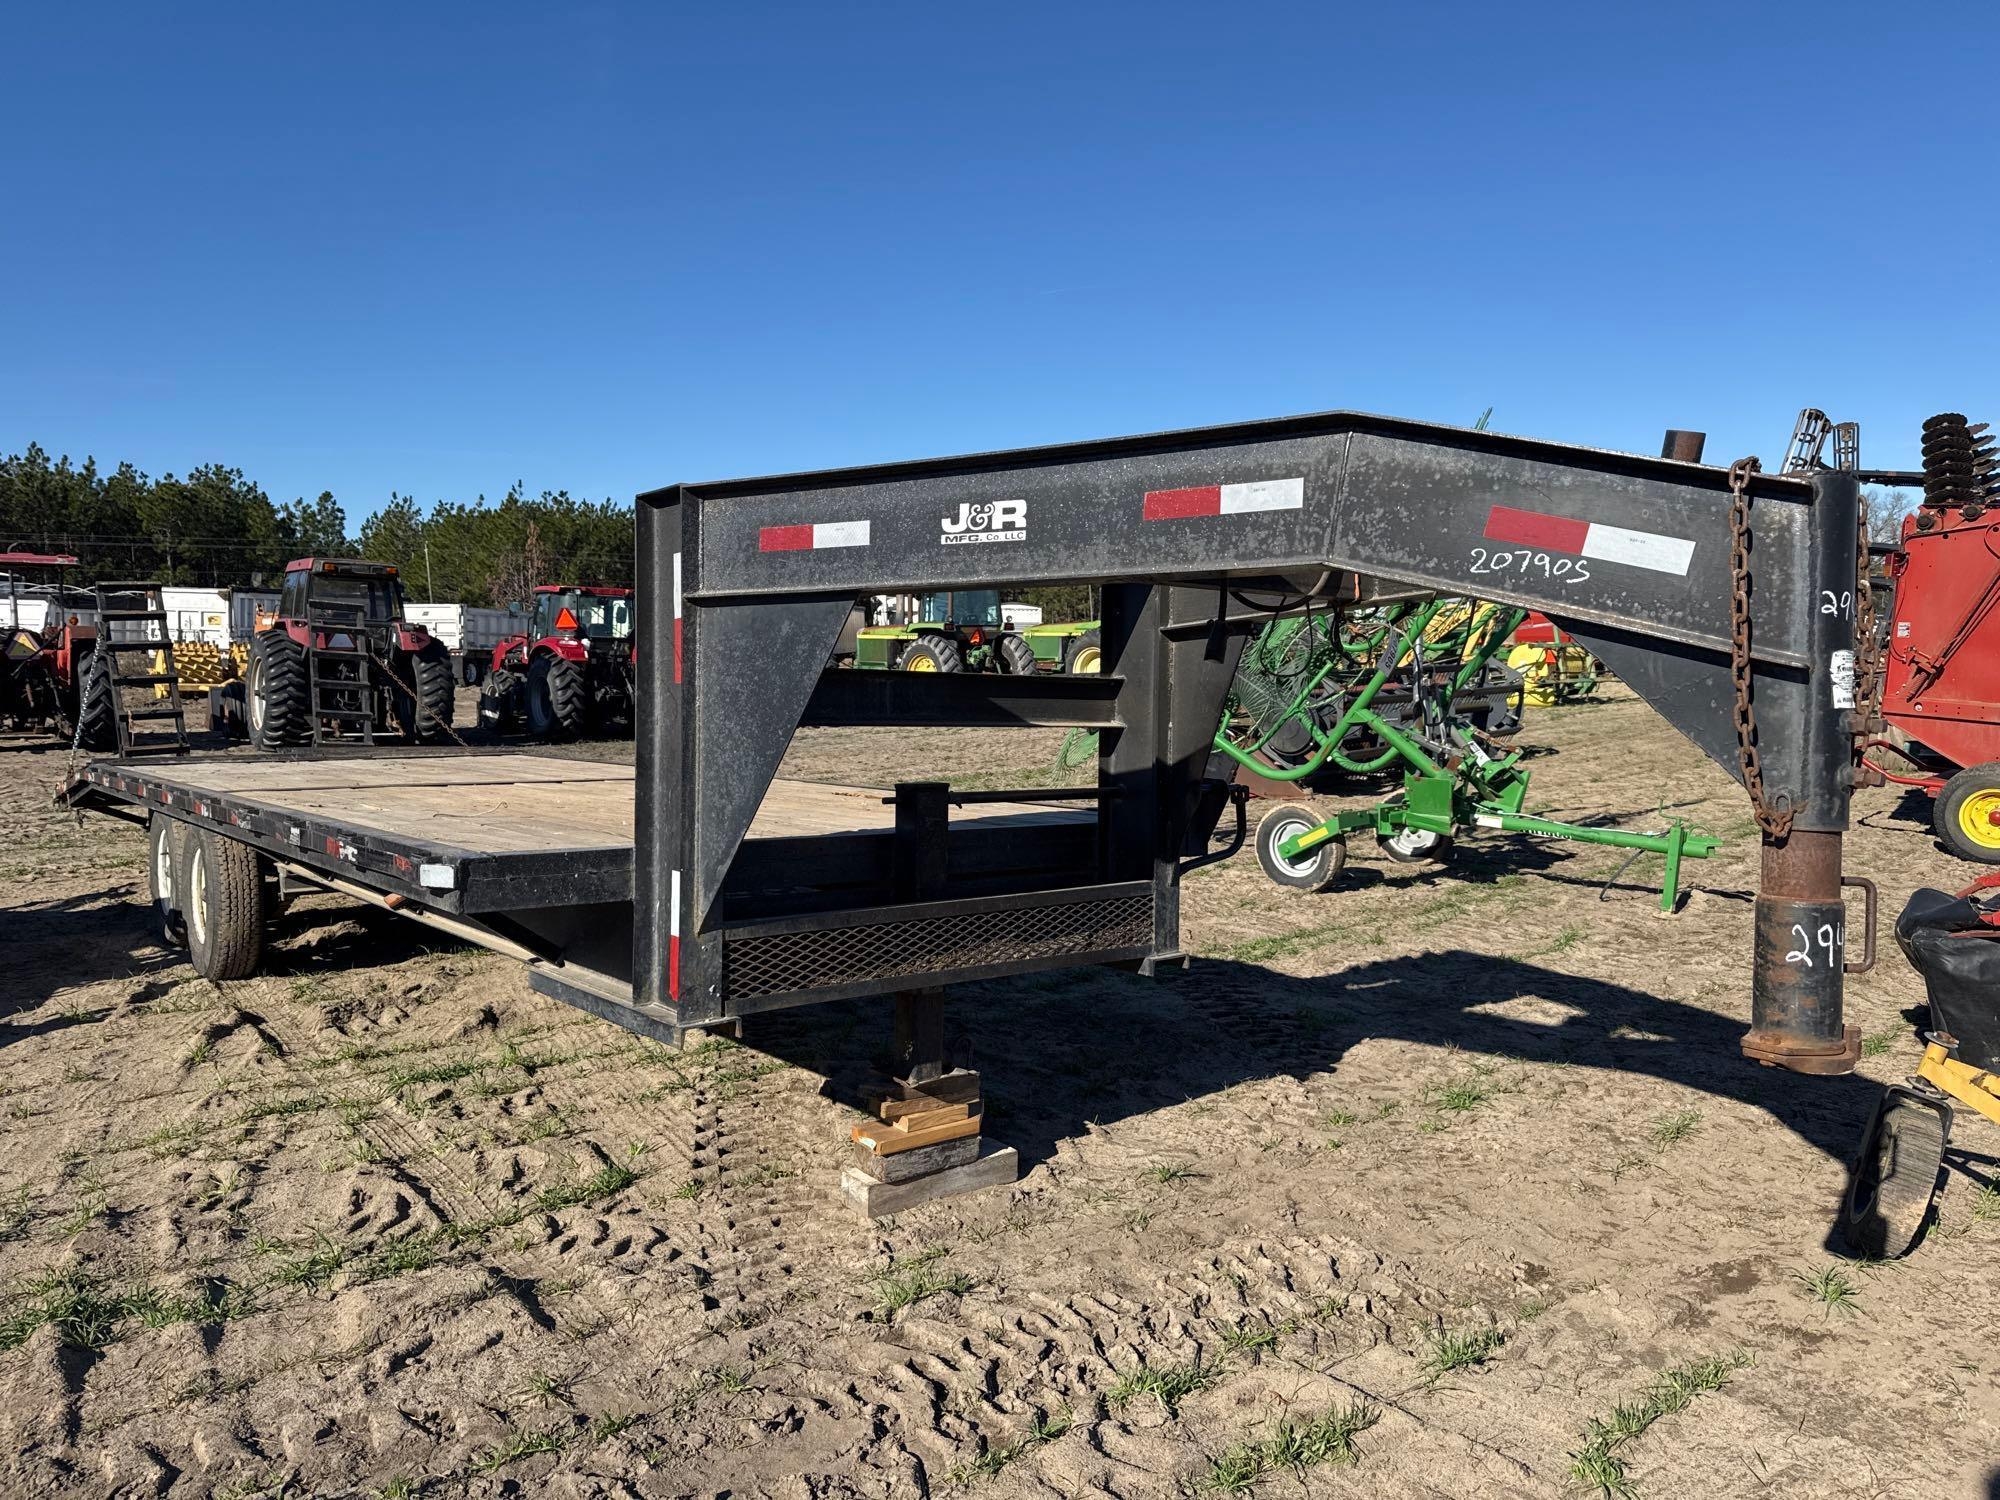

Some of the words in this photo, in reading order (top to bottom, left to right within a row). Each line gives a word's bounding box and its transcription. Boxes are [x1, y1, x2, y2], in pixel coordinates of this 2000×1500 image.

[941, 499, 1027, 533] J&R
[944, 534, 983, 543] MFG.
[1004, 531, 1024, 540] LLC
[1469, 548, 1591, 584] 207905
